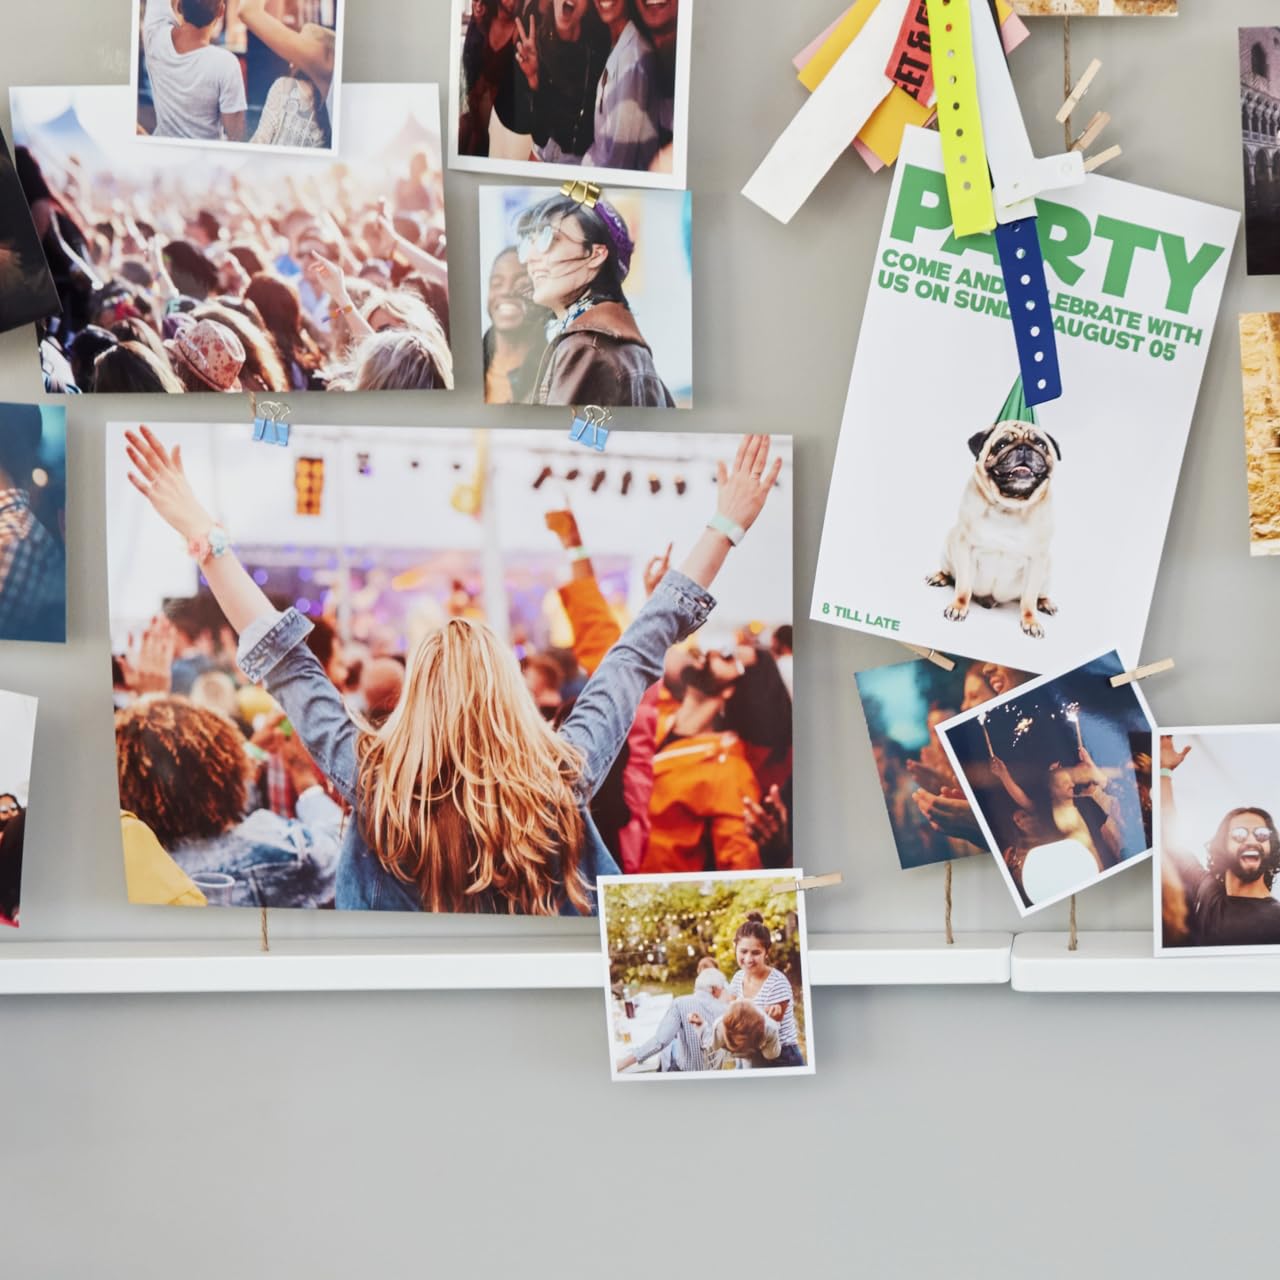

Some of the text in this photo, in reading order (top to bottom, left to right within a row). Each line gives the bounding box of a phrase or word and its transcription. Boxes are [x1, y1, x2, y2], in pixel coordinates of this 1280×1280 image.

[890, 163, 1226, 314] PRTY
[877, 269, 1177, 362] US ON SUN AUGUST 05
[881, 249, 1203, 346] COME AND EBRATE WITH
[822, 602, 901, 632] 8 TILL LATE
